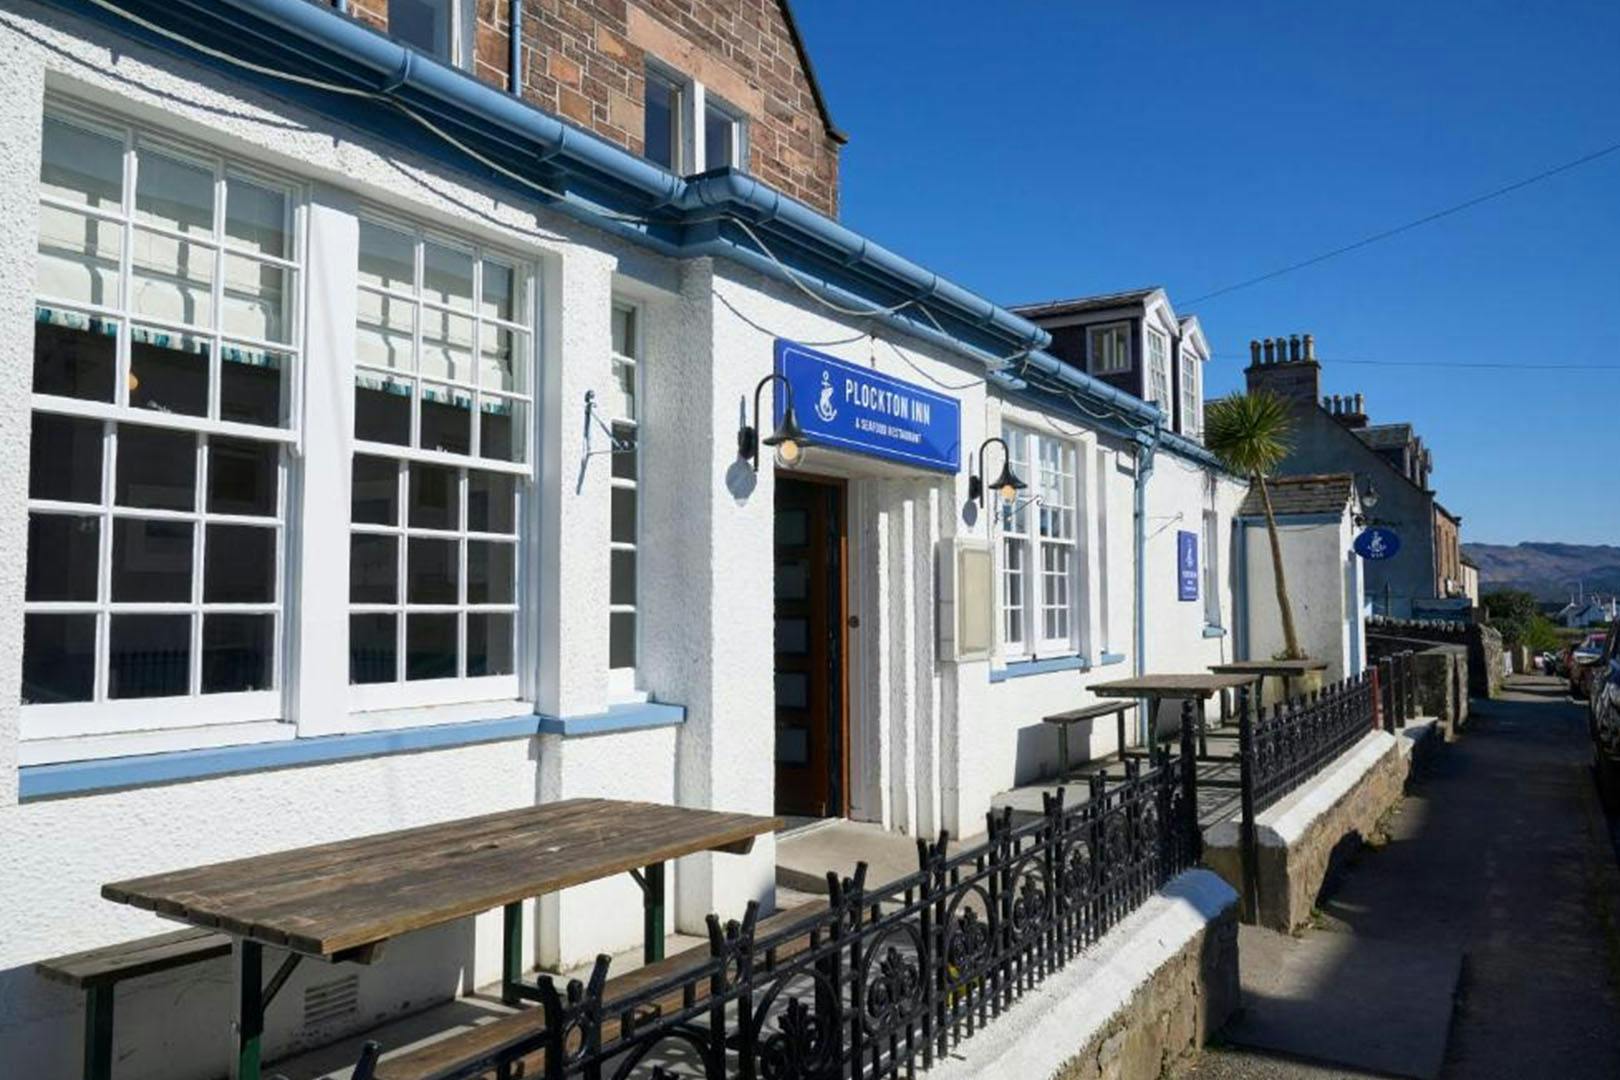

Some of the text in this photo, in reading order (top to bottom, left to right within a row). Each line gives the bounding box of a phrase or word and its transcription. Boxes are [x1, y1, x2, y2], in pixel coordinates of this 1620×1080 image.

[845, 379, 930, 425] PLOCKTON INN
[861, 418, 887, 435] SEAFOOD
